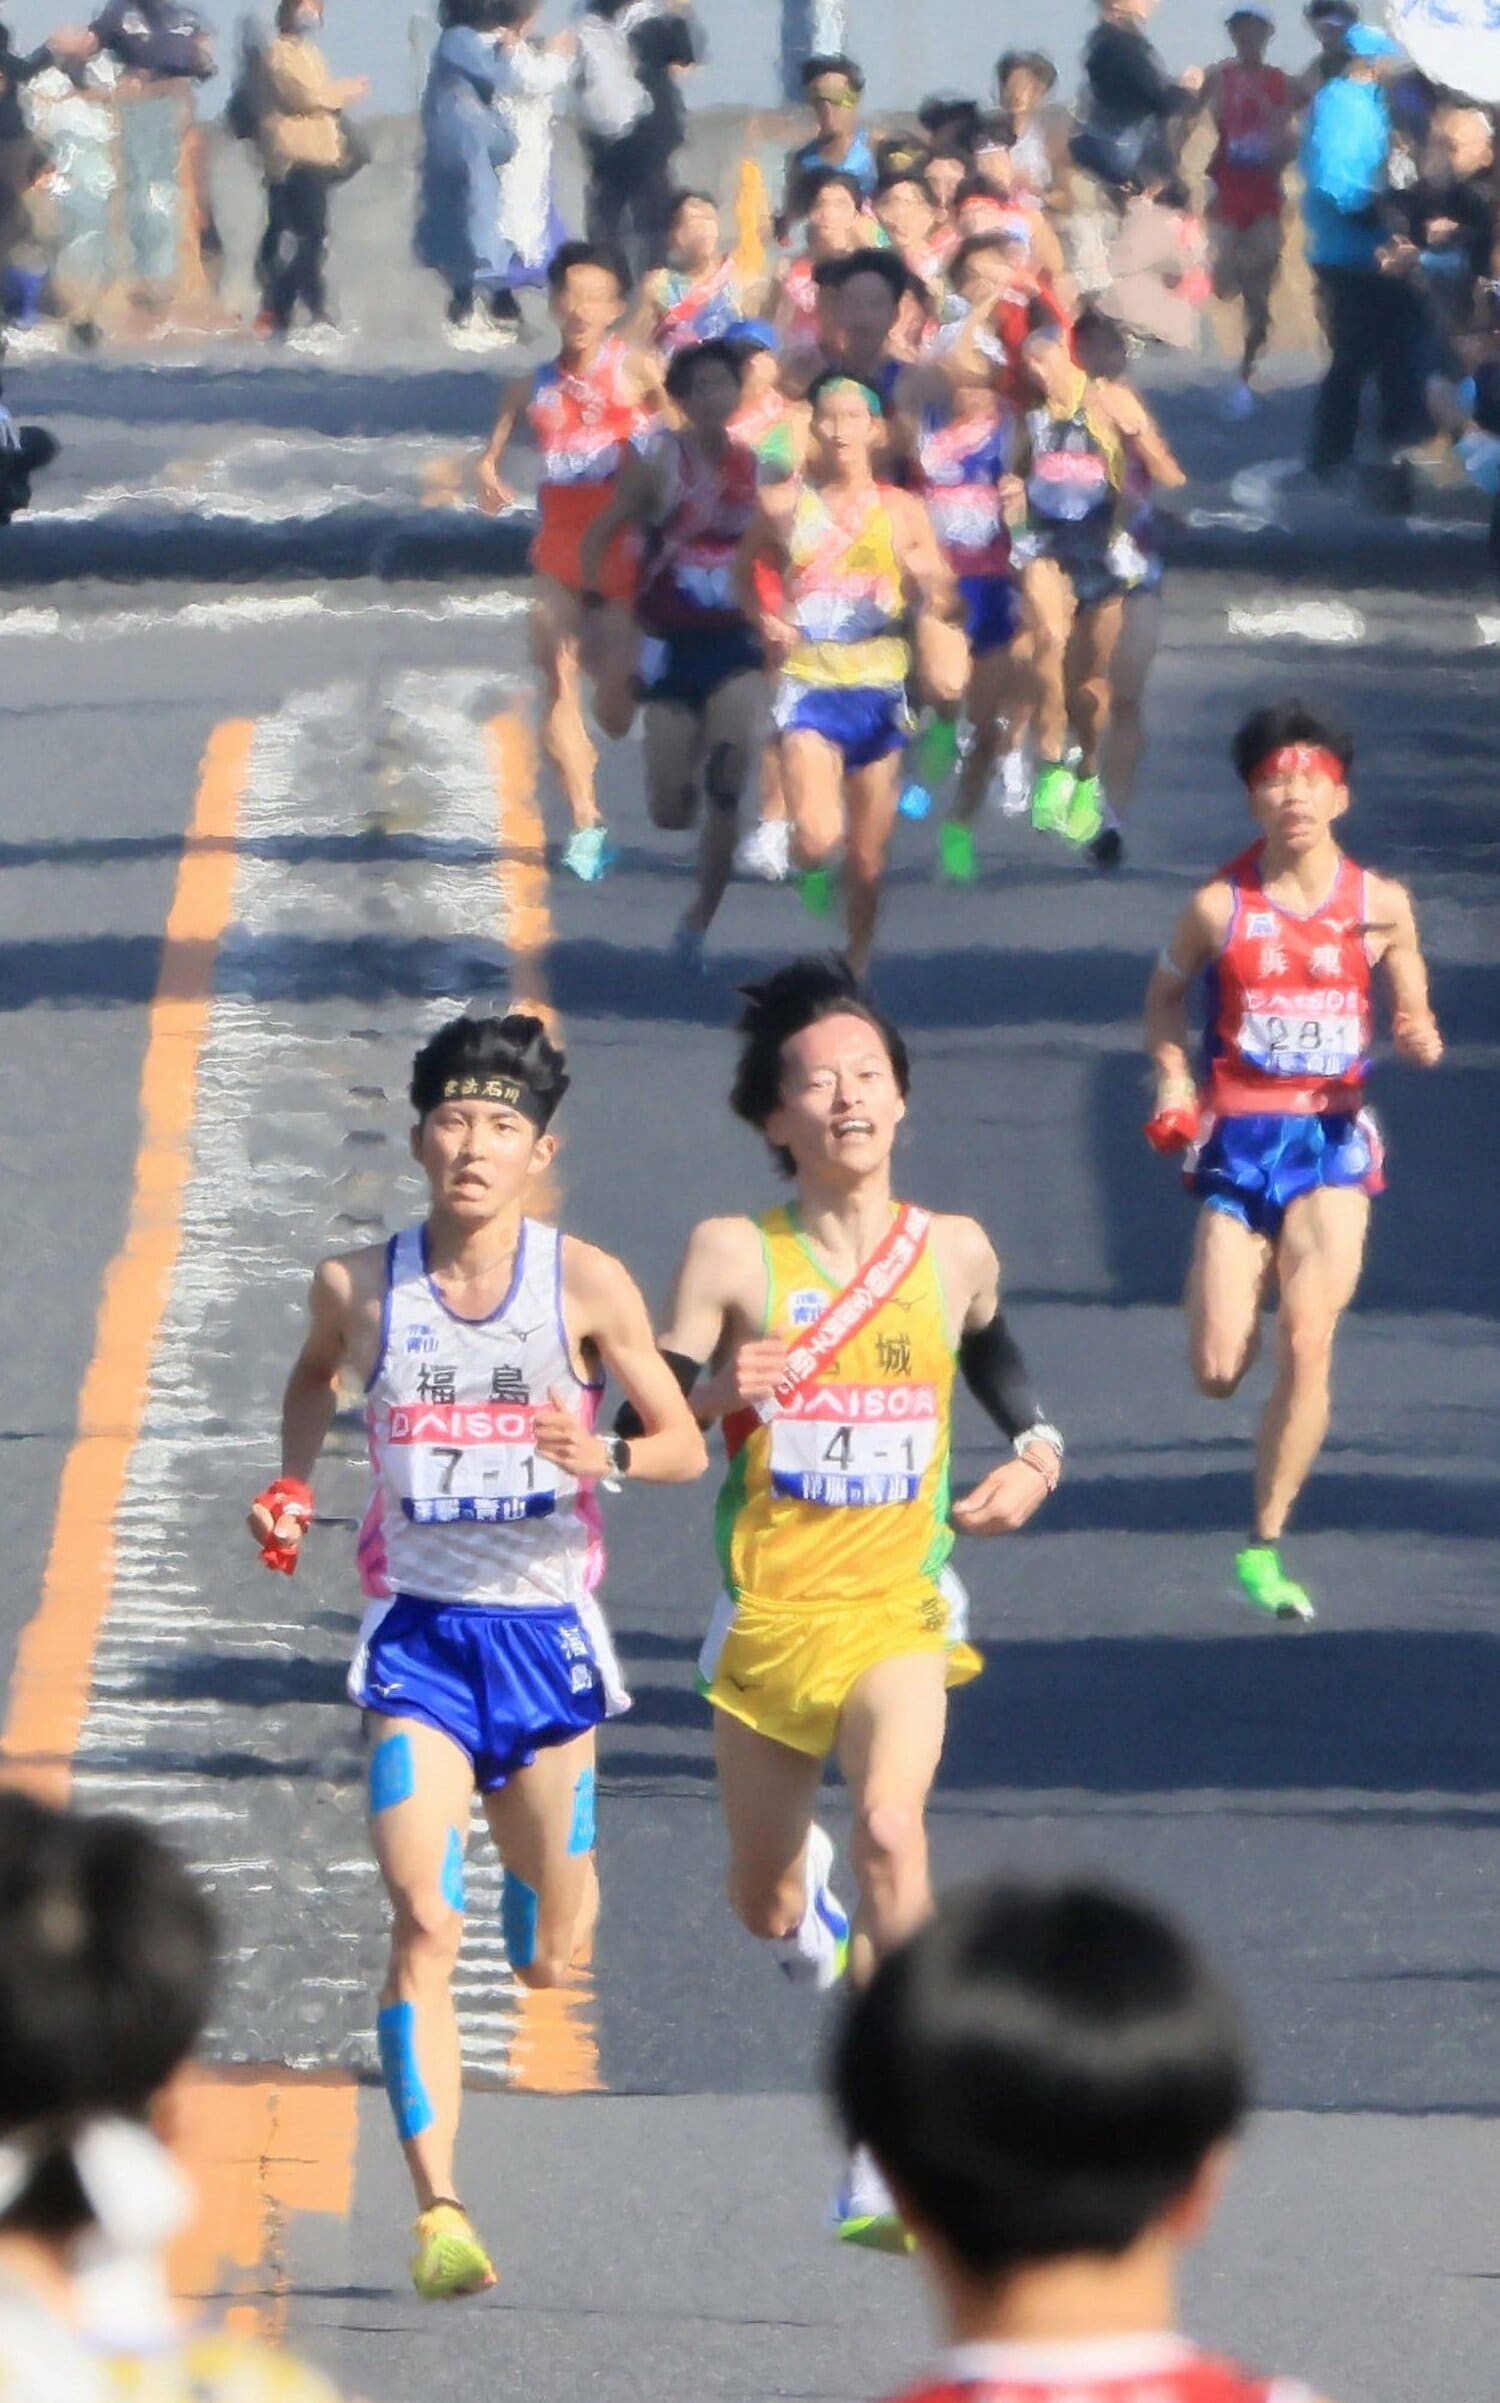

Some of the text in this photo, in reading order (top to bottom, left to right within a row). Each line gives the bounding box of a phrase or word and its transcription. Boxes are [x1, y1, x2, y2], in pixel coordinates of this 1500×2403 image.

[416, 1363, 530, 1405] 福島
[432, 1447, 535, 1495] 7-1
[823, 1426, 914, 1471] 4-1
